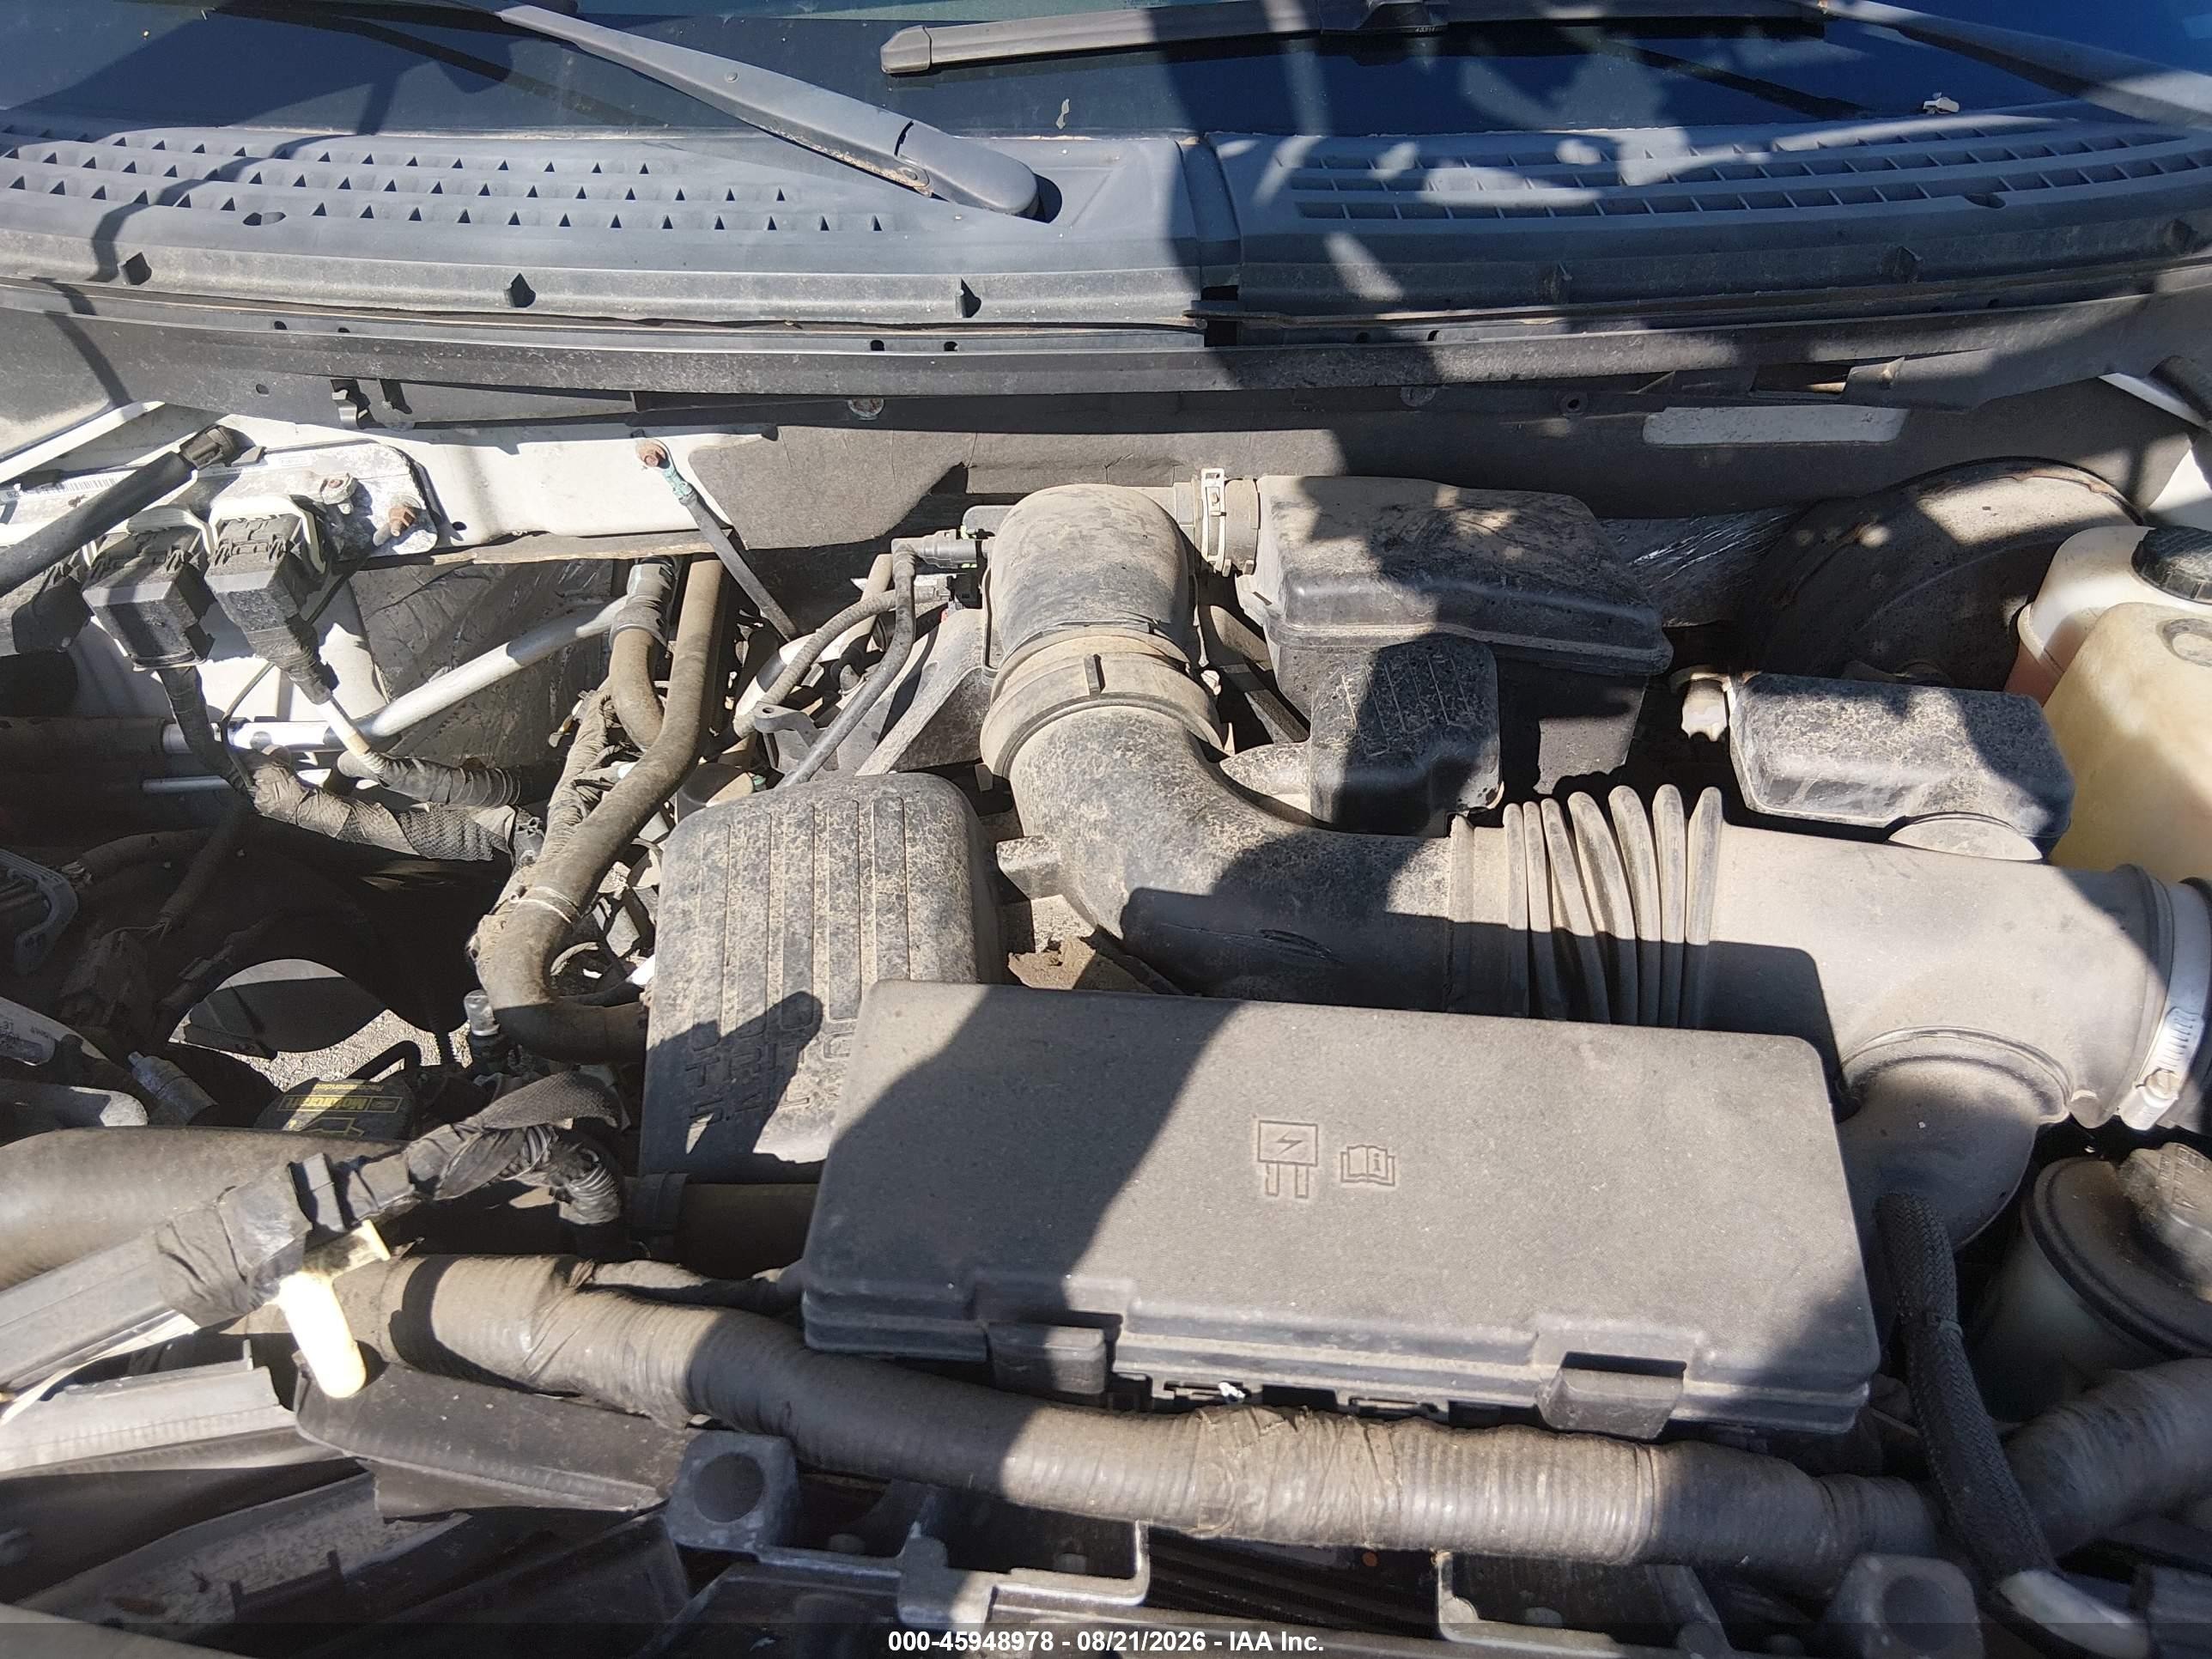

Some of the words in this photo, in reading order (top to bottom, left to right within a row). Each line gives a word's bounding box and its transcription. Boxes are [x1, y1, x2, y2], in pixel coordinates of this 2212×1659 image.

[685, 1031, 854, 1089] TRITO
[314, 1084, 384, 1092] Recommended
[285, 1097, 369, 1110] Motorcraft
